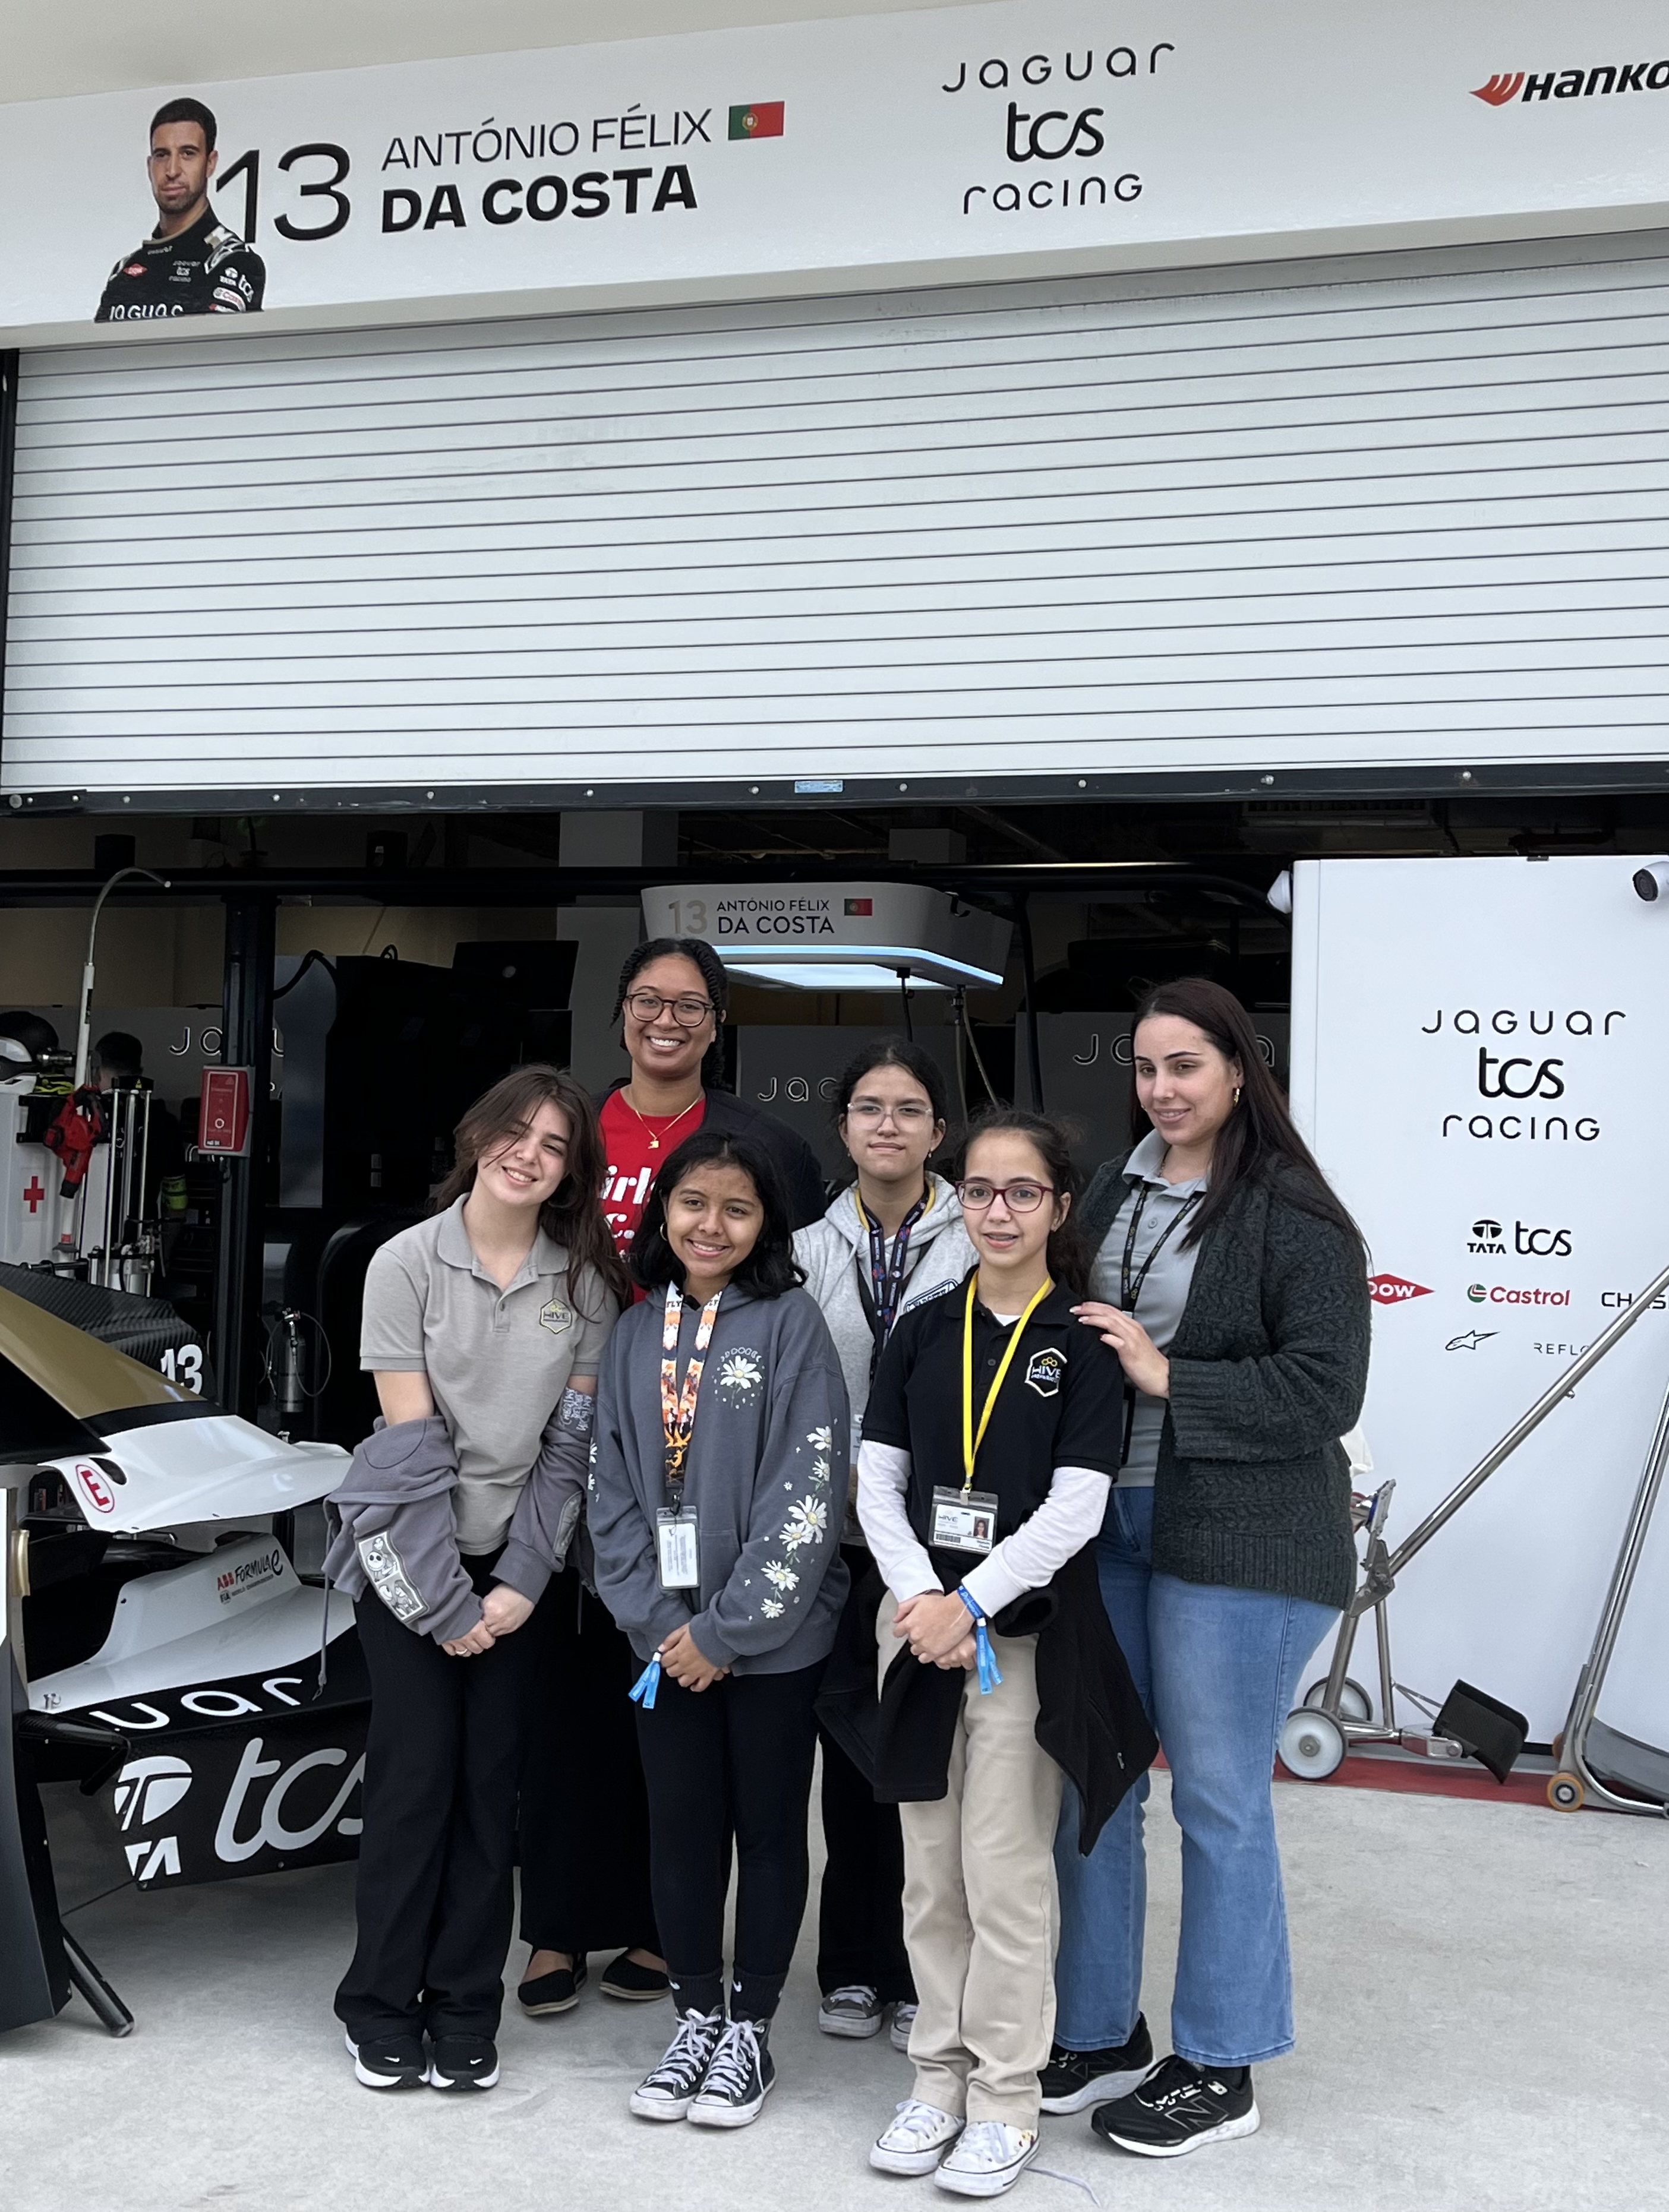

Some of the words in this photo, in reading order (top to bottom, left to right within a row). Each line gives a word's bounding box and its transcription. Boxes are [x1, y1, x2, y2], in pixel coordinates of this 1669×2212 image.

[381, 116, 579, 171] ANTÓNIO
[592, 103, 711, 152] FÉLIX
[1007, 102, 1104, 162] tcs
[216, 143, 351, 244] 13
[382, 184, 466, 233] DA
[482, 164, 698, 225] COSTA
[668, 900, 708, 934] 13
[717, 897, 786, 912] ANTÓNIO
[789, 896, 830, 911] FÉLIX
[718, 917, 750, 934] DA
[756, 915, 835, 934] COSTA
[1479, 1047, 1564, 1099] tcs
[1467, 1243, 1506, 1254] TATA
[1515, 1221, 1572, 1256] tcs
[1490, 1286, 1570, 1306] Castrol
[160, 1344, 203, 1395] 13
[1031, 1366, 1061, 1378] HIVE
[217, 1572, 235, 1591] ABB
